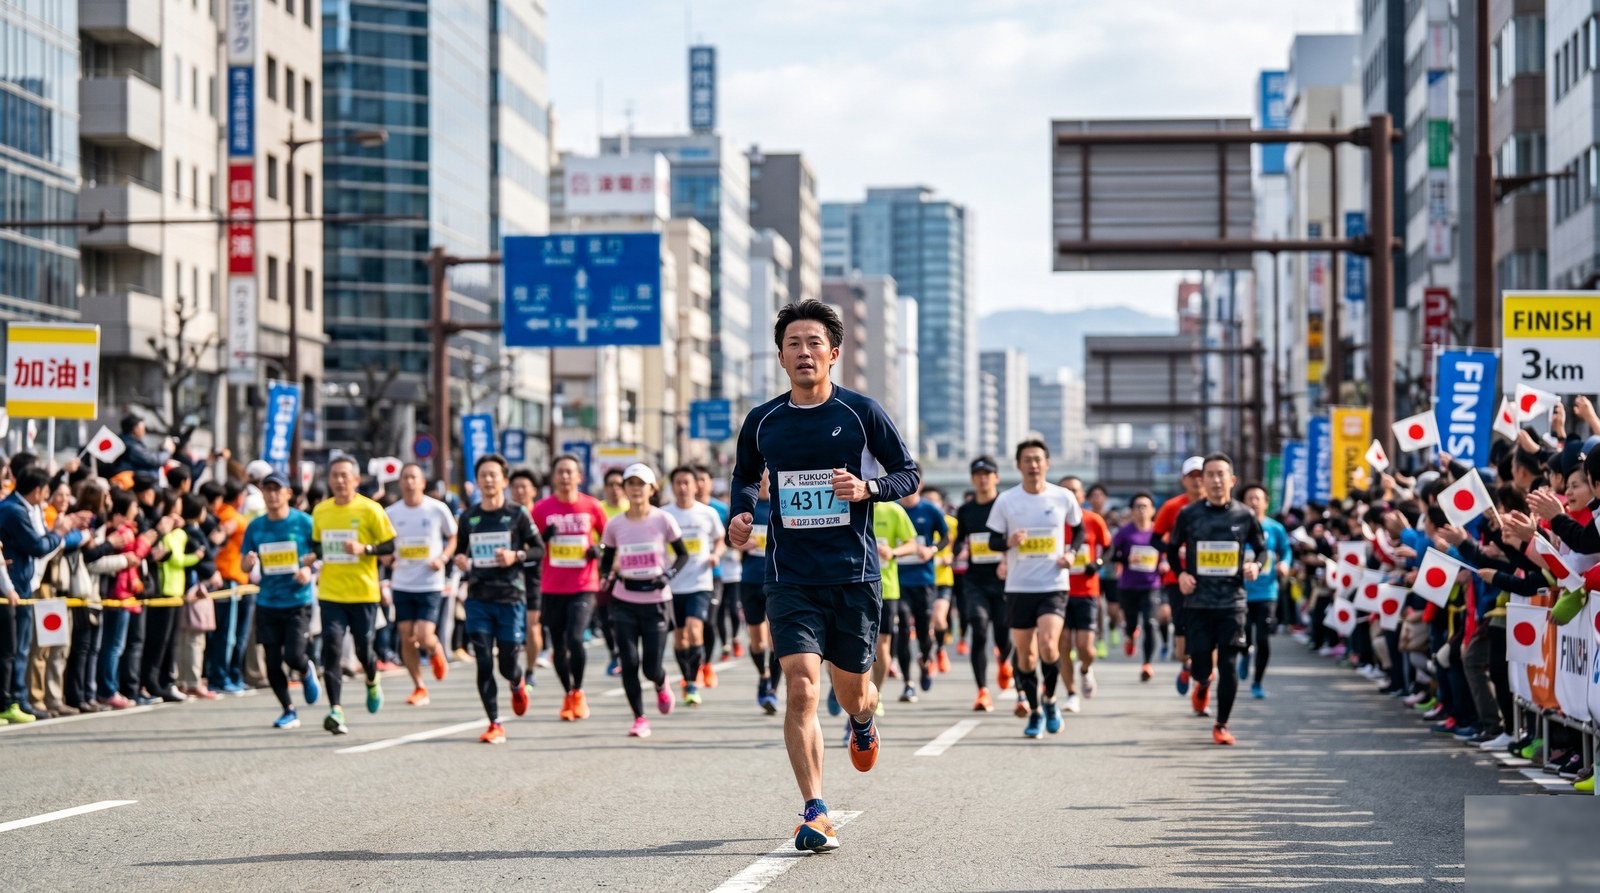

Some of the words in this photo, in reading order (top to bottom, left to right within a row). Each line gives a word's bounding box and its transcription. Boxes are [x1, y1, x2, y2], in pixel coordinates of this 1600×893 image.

[1513, 311, 1591, 331] FINISH
[14, 357, 91, 388] 加油!
[790, 490, 835, 511] 4317
